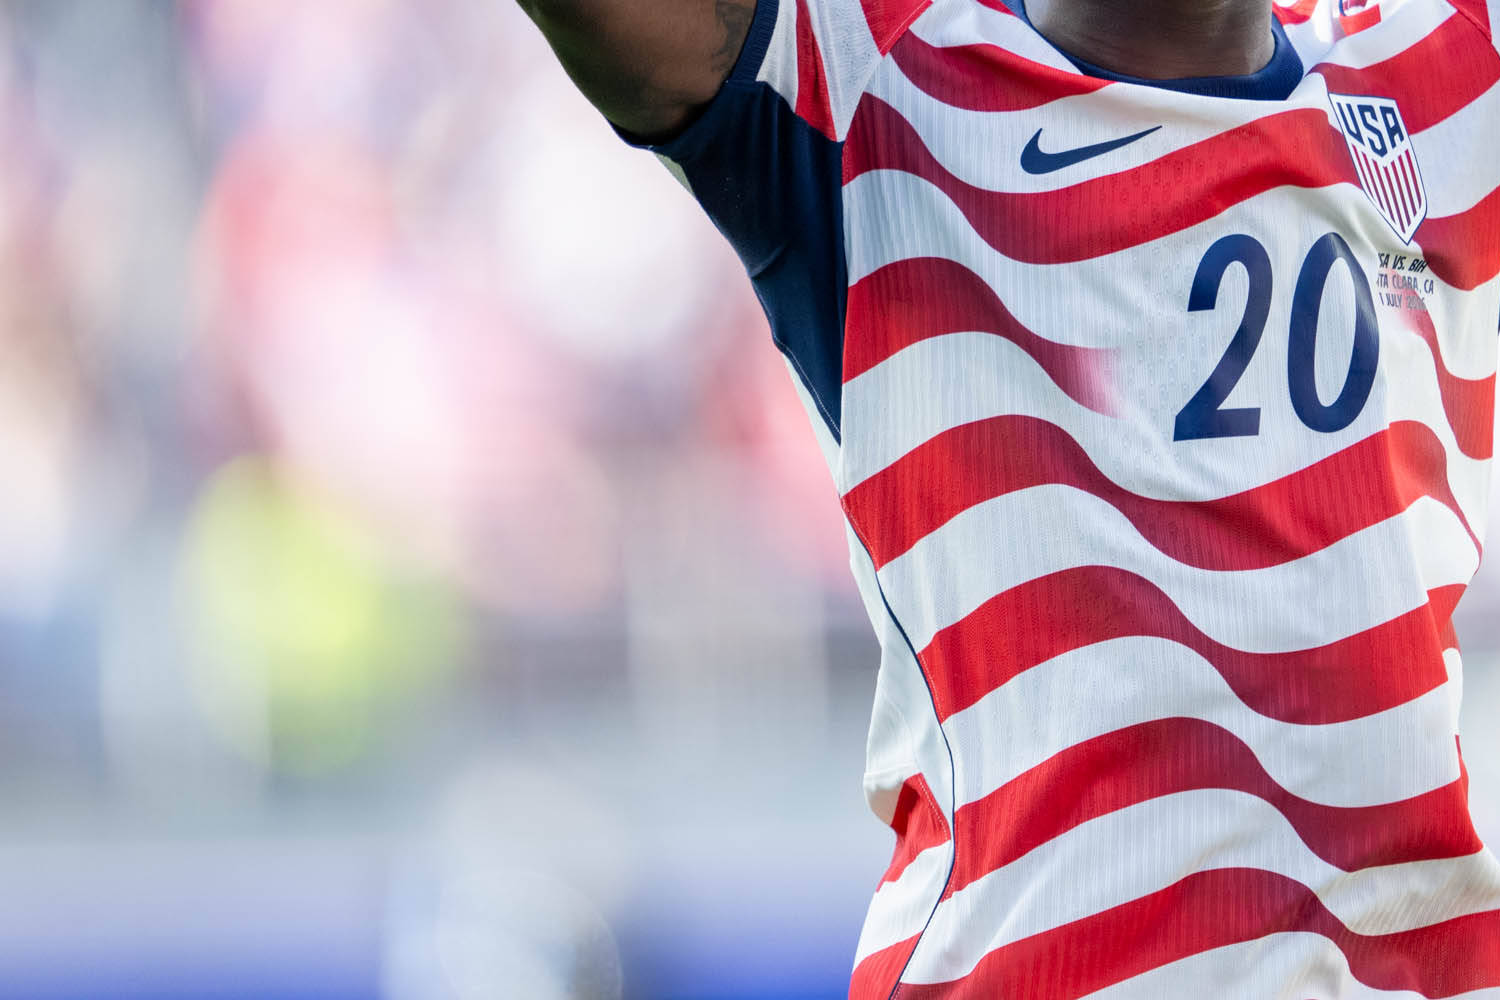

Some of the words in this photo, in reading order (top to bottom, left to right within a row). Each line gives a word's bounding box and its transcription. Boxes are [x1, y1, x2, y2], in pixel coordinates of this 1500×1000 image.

[1336, 102, 1405, 158] USA
[1378, 253, 1390, 269] SA
[1392, 255, 1406, 270] VS.
[1424, 279, 1434, 295] CA
[1173, 232, 1380, 442] 20
